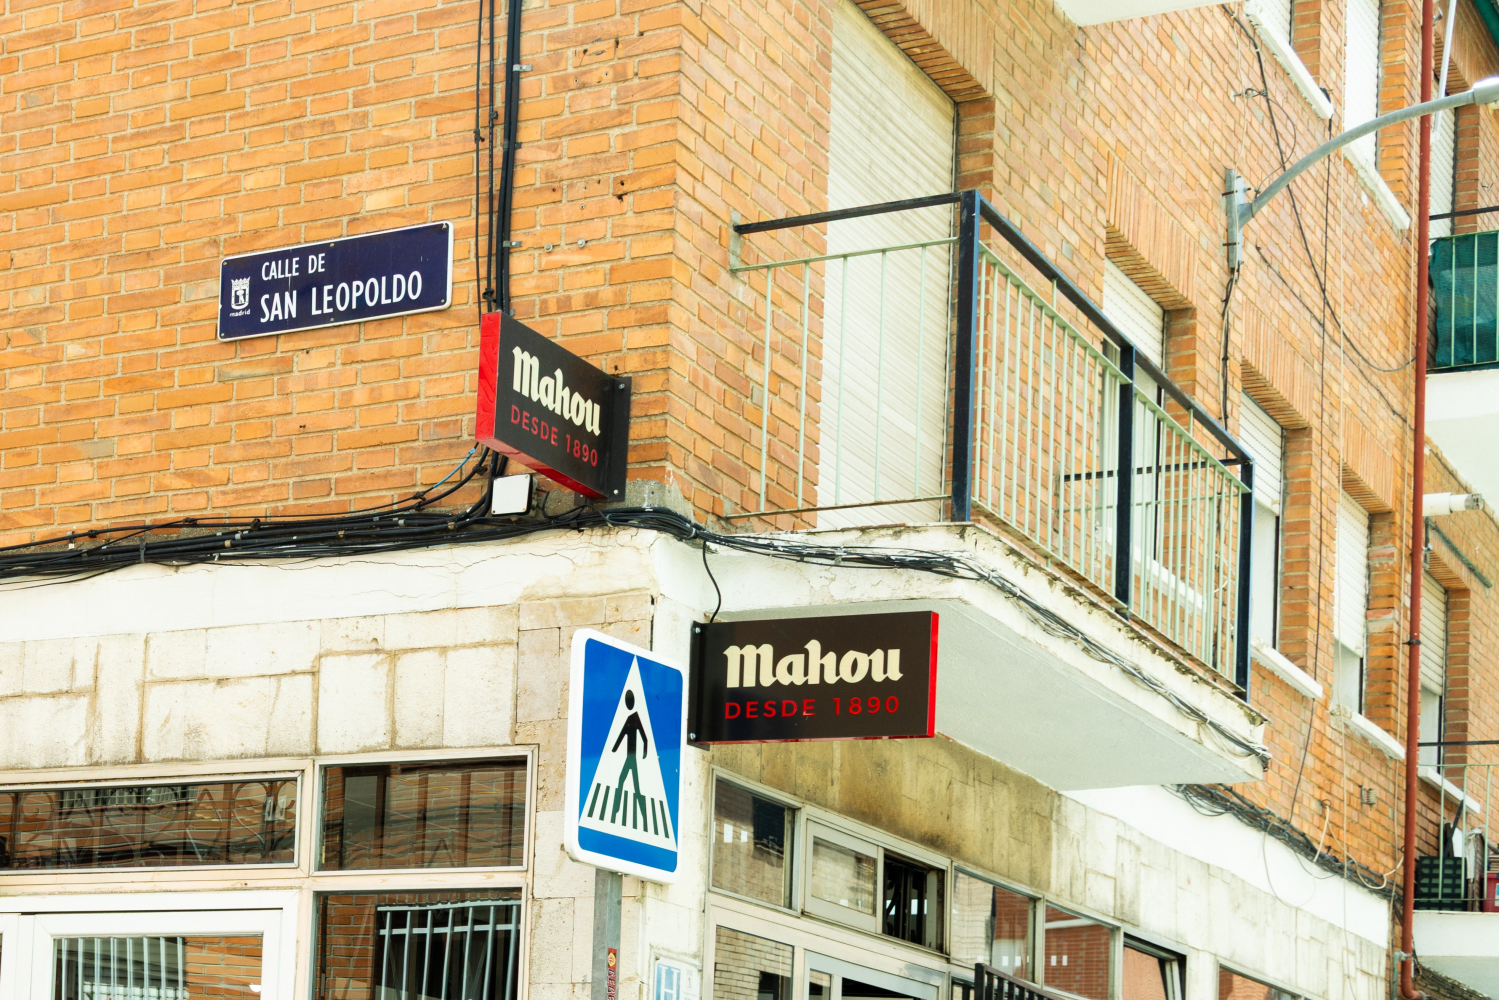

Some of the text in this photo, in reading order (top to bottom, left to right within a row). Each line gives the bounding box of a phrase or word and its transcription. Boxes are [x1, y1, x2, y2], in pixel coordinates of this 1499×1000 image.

[261, 253, 326, 281] CALLE DE
[260, 270, 423, 323] SAN LEOPOLDO
[512, 346, 601, 436] Mahou
[511, 405, 598, 467] DESDE 1890
[723, 639, 903, 688] Mahou
[724, 695, 899, 719] DESDE 1890
